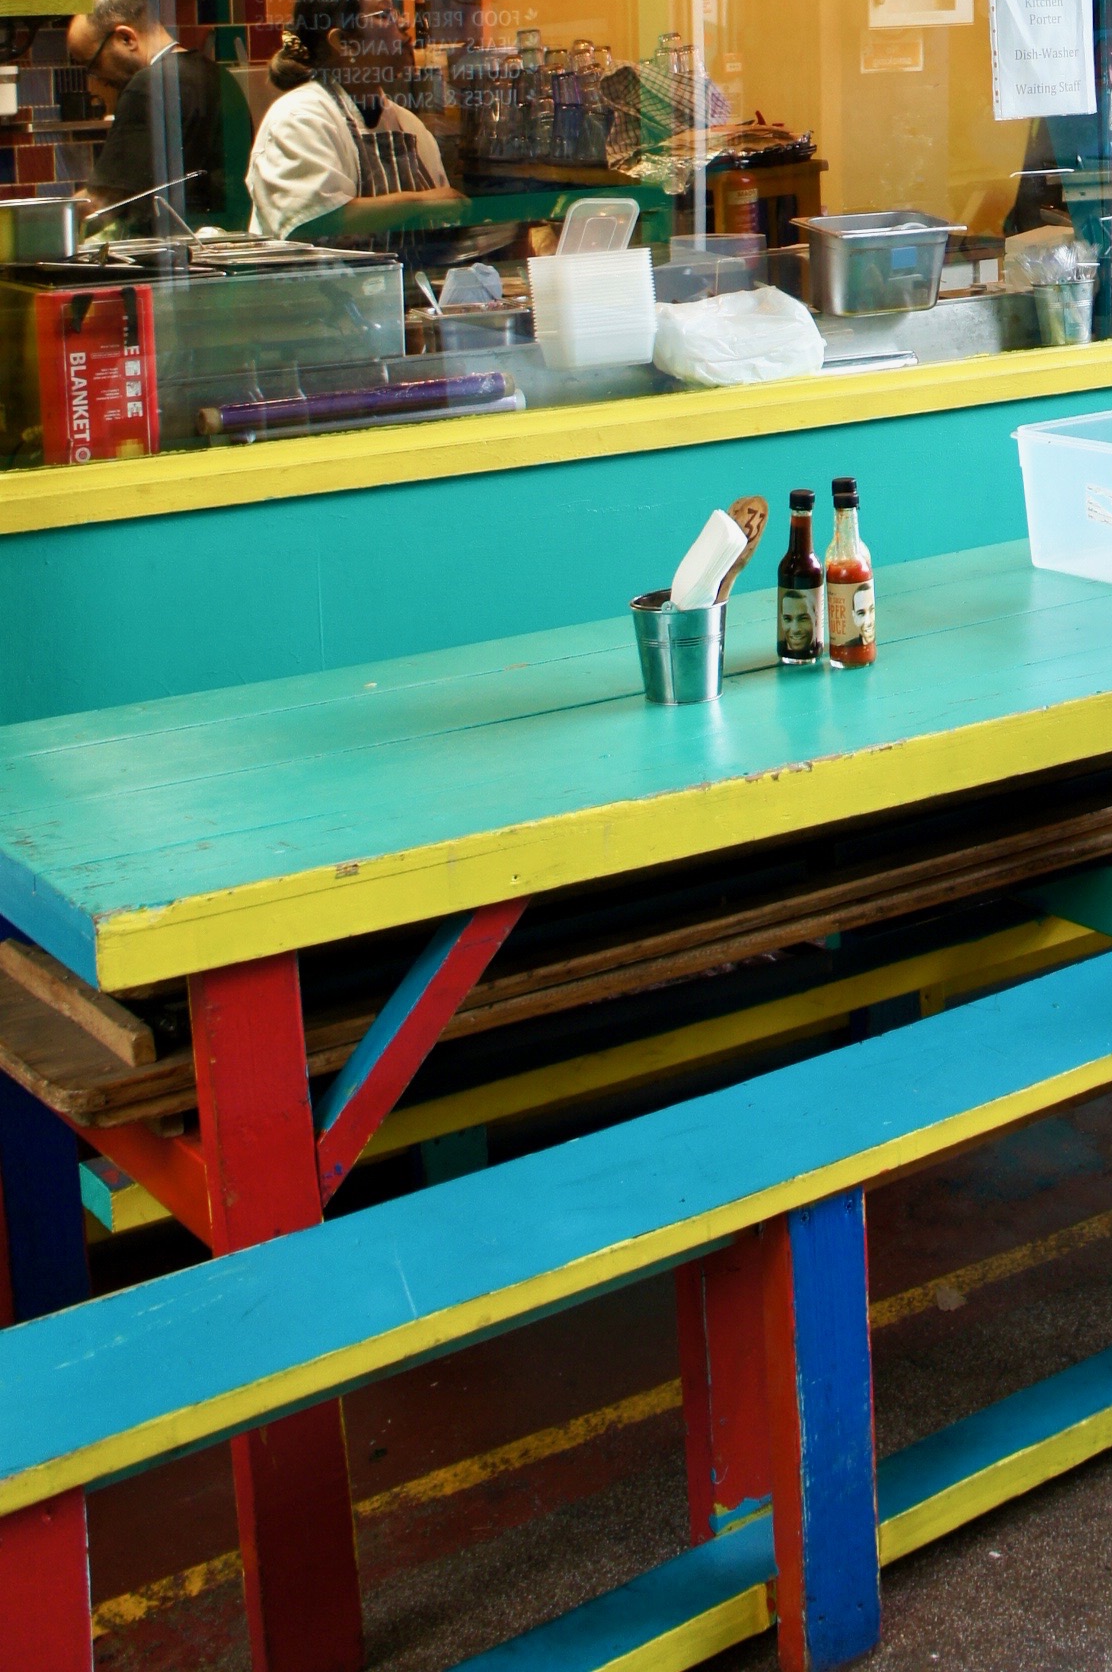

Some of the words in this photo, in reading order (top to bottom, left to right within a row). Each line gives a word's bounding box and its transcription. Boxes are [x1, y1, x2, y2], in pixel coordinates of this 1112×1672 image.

[1029, 13, 1062, 25] Porter
[1015, 47, 1080, 61] Dish-Washer
[1015, 82, 1057, 96] Waiting
[1059, 79, 1082, 93] Staff
[69, 351, 91, 443] BLANKET
